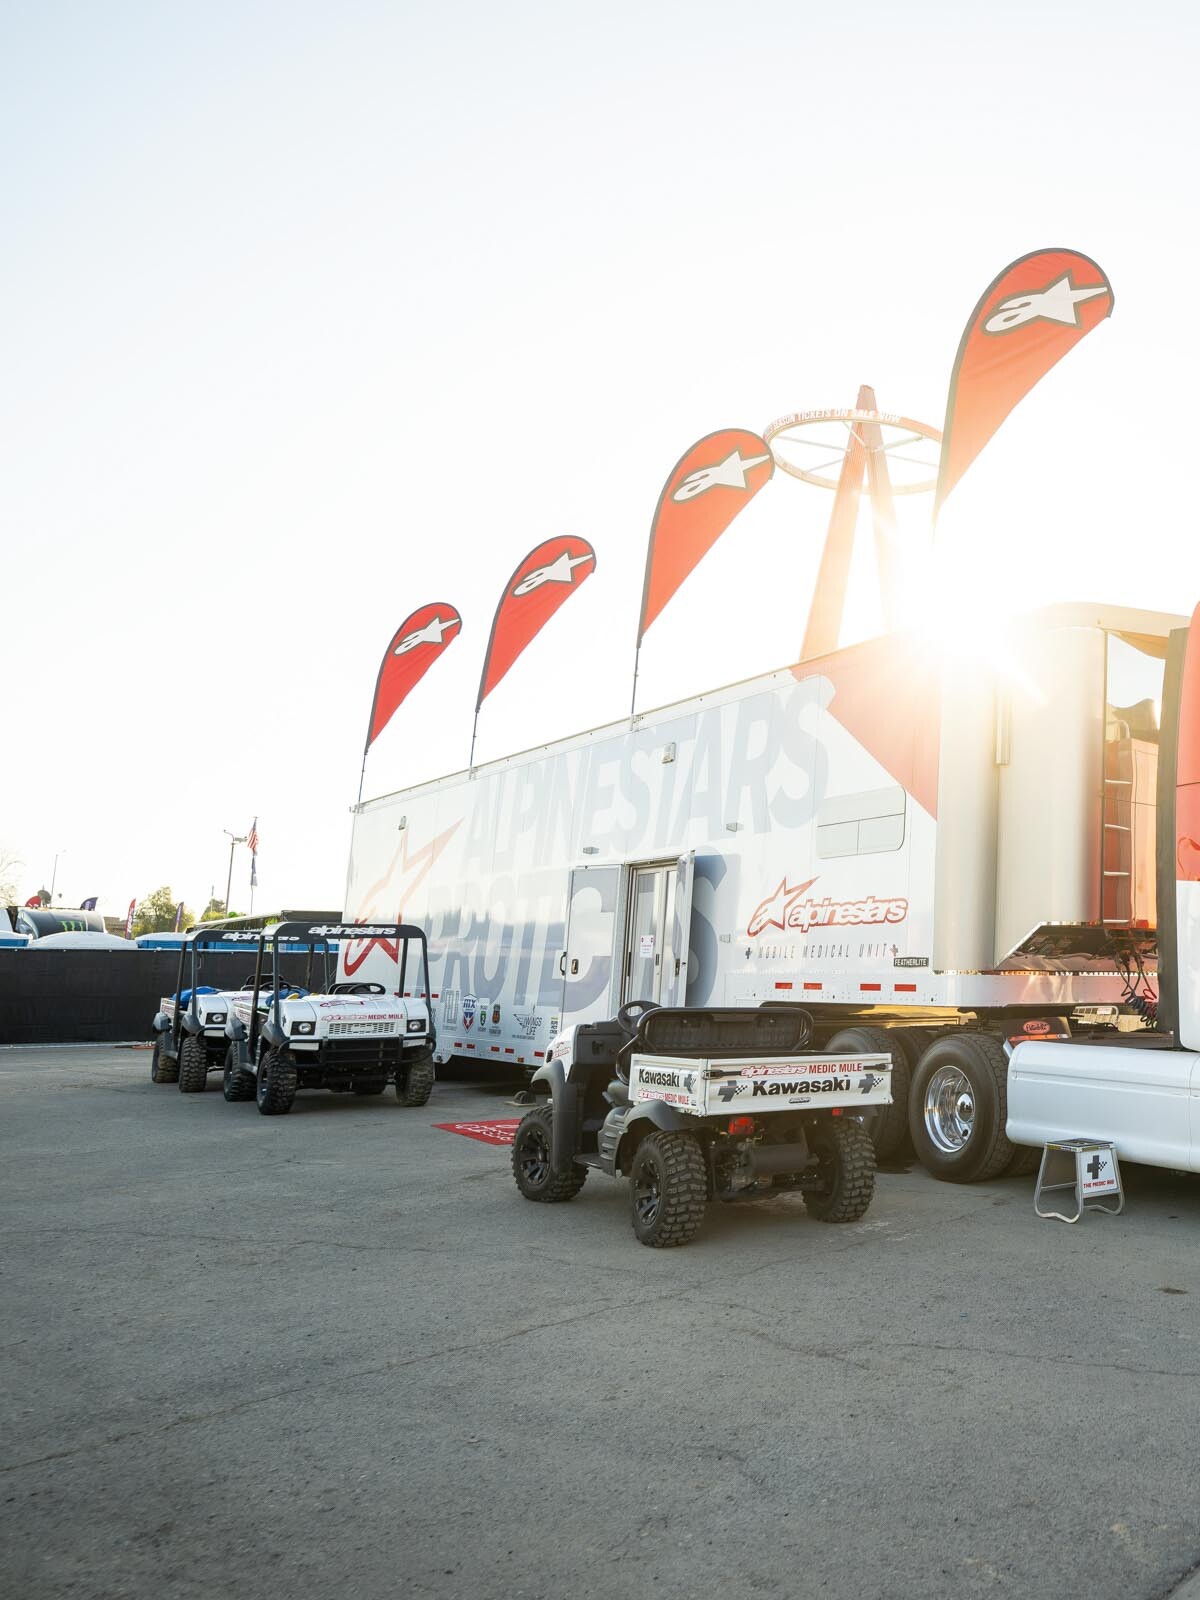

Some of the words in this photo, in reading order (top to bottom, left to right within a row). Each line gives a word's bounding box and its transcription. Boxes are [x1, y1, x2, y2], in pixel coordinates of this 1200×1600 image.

[797, 409, 831, 422] TICKETS
[833, 408, 849, 417] ON
[459, 674, 836, 877] ALPINESTARS
[788, 896, 909, 933] alpinestars
[308, 924, 396, 936] alpinestars
[413, 845, 728, 1013] PROTECS
[758, 944, 796, 959] MOBILE
[802, 943, 850, 959] MEDICAL
[858, 942, 888, 958] UNIT
[894, 957, 928, 967] FEATHERLITE
[638, 1067, 680, 1088] Kawasaki
[740, 1064, 808, 1079] alpinestars
[808, 1063, 836, 1075] MEDIC
[838, 1062, 863, 1073] MULE
[752, 1074, 851, 1098] Kawasaki
[664, 1092, 678, 1104] MEDIC
[677, 1094, 690, 1105] MULE
[1092, 1179, 1106, 1187] MEDIC
